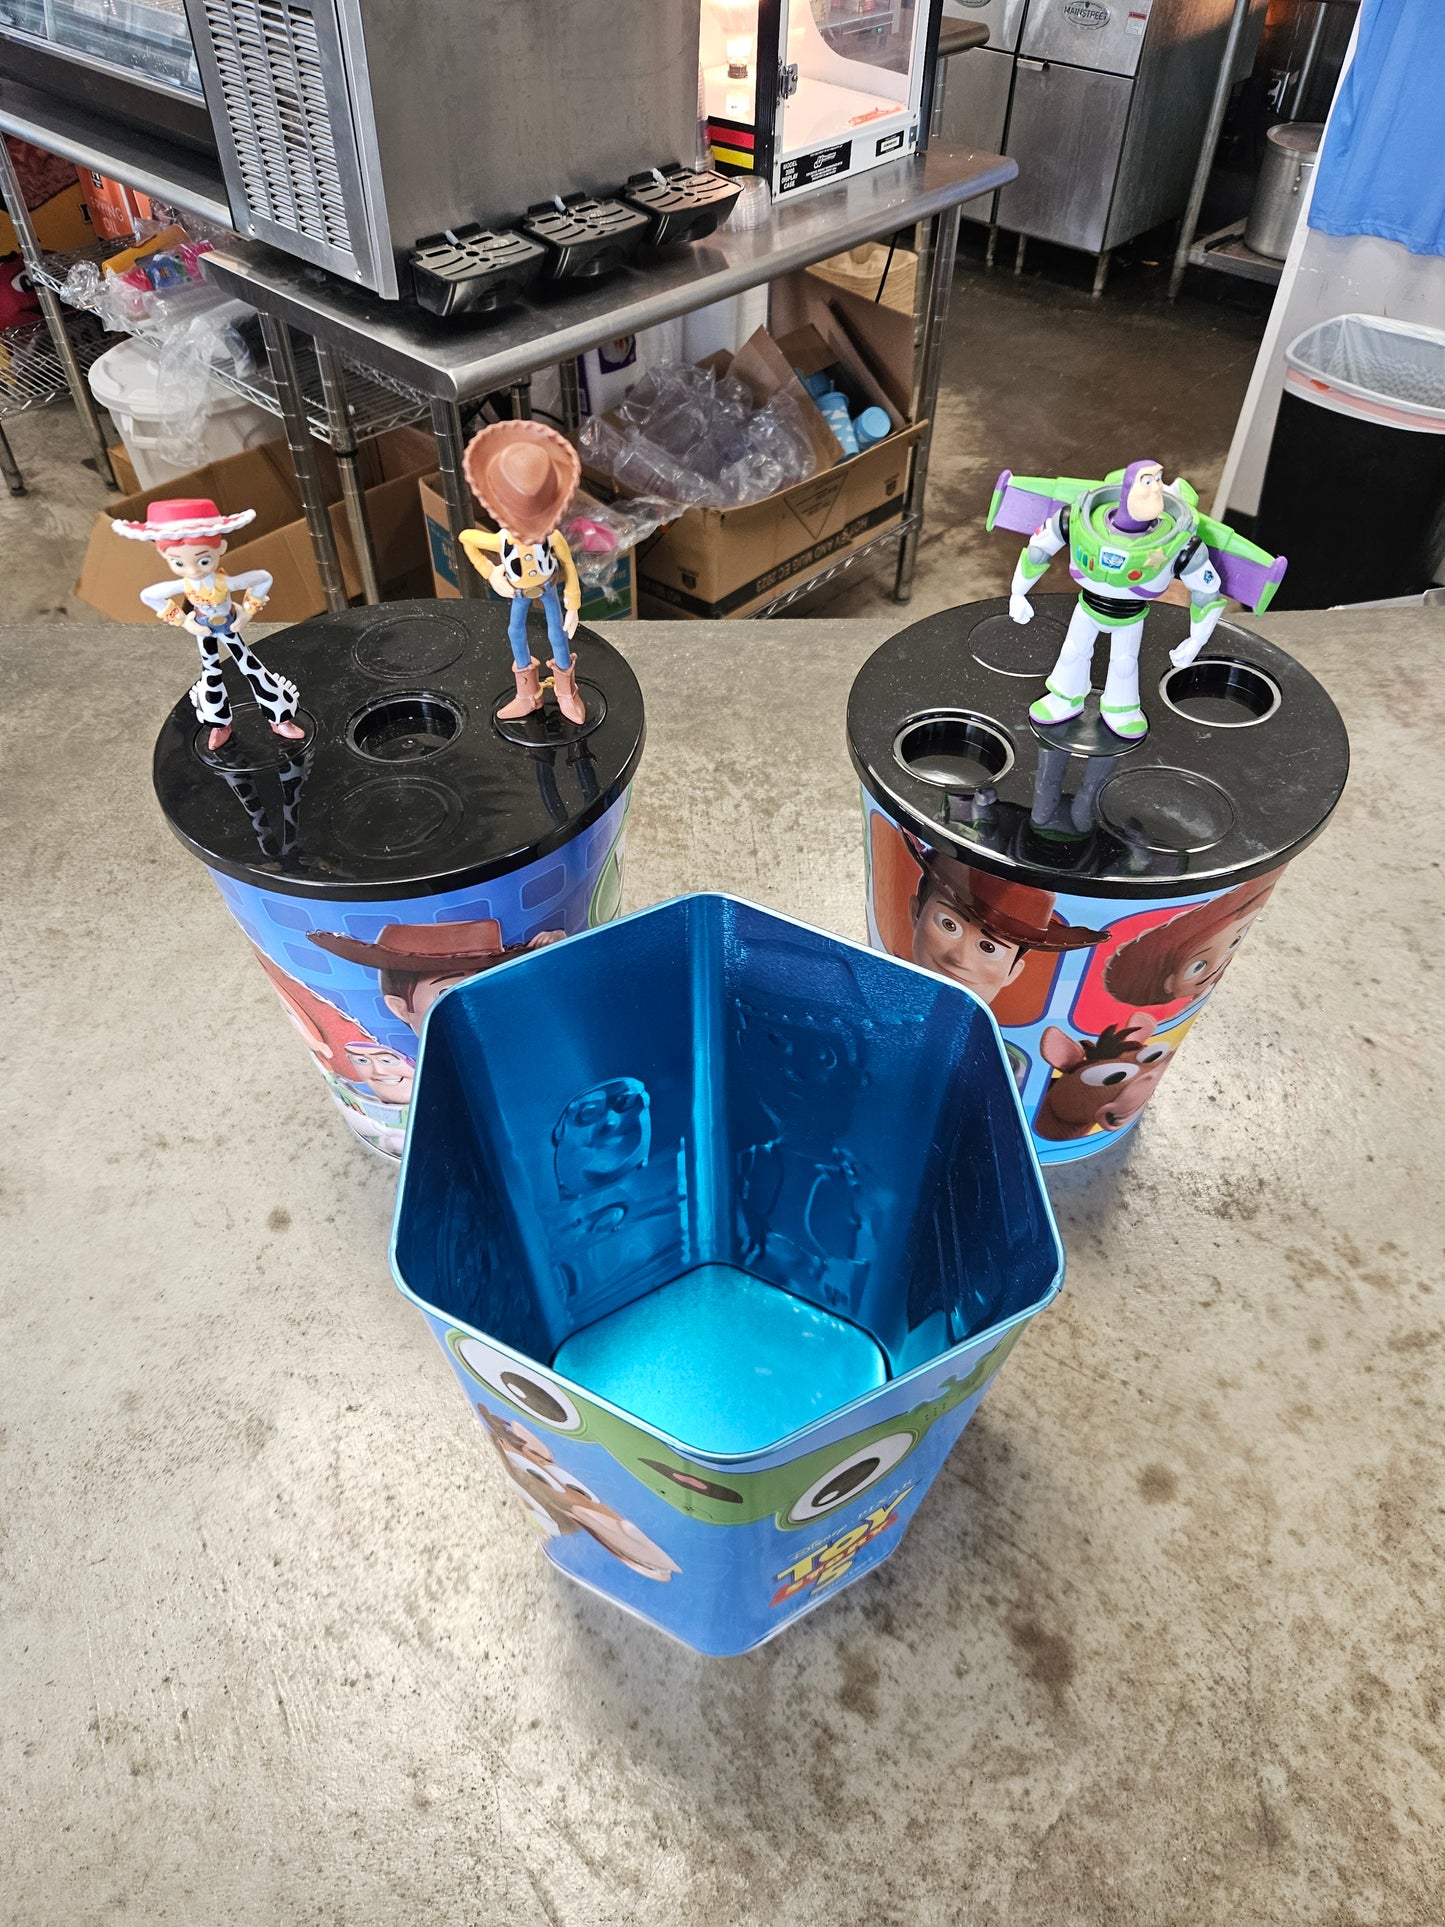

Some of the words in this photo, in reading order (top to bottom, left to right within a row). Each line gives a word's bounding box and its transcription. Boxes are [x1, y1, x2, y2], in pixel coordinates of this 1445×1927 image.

[781, 172, 799, 185] DISPLAY
[783, 180, 796, 190] CASE
[102, 216, 120, 236] OIL
[776, 1483, 916, 1582] TOY
[785, 1519, 888, 1596] STORY
[809, 1550, 854, 1596] 5
